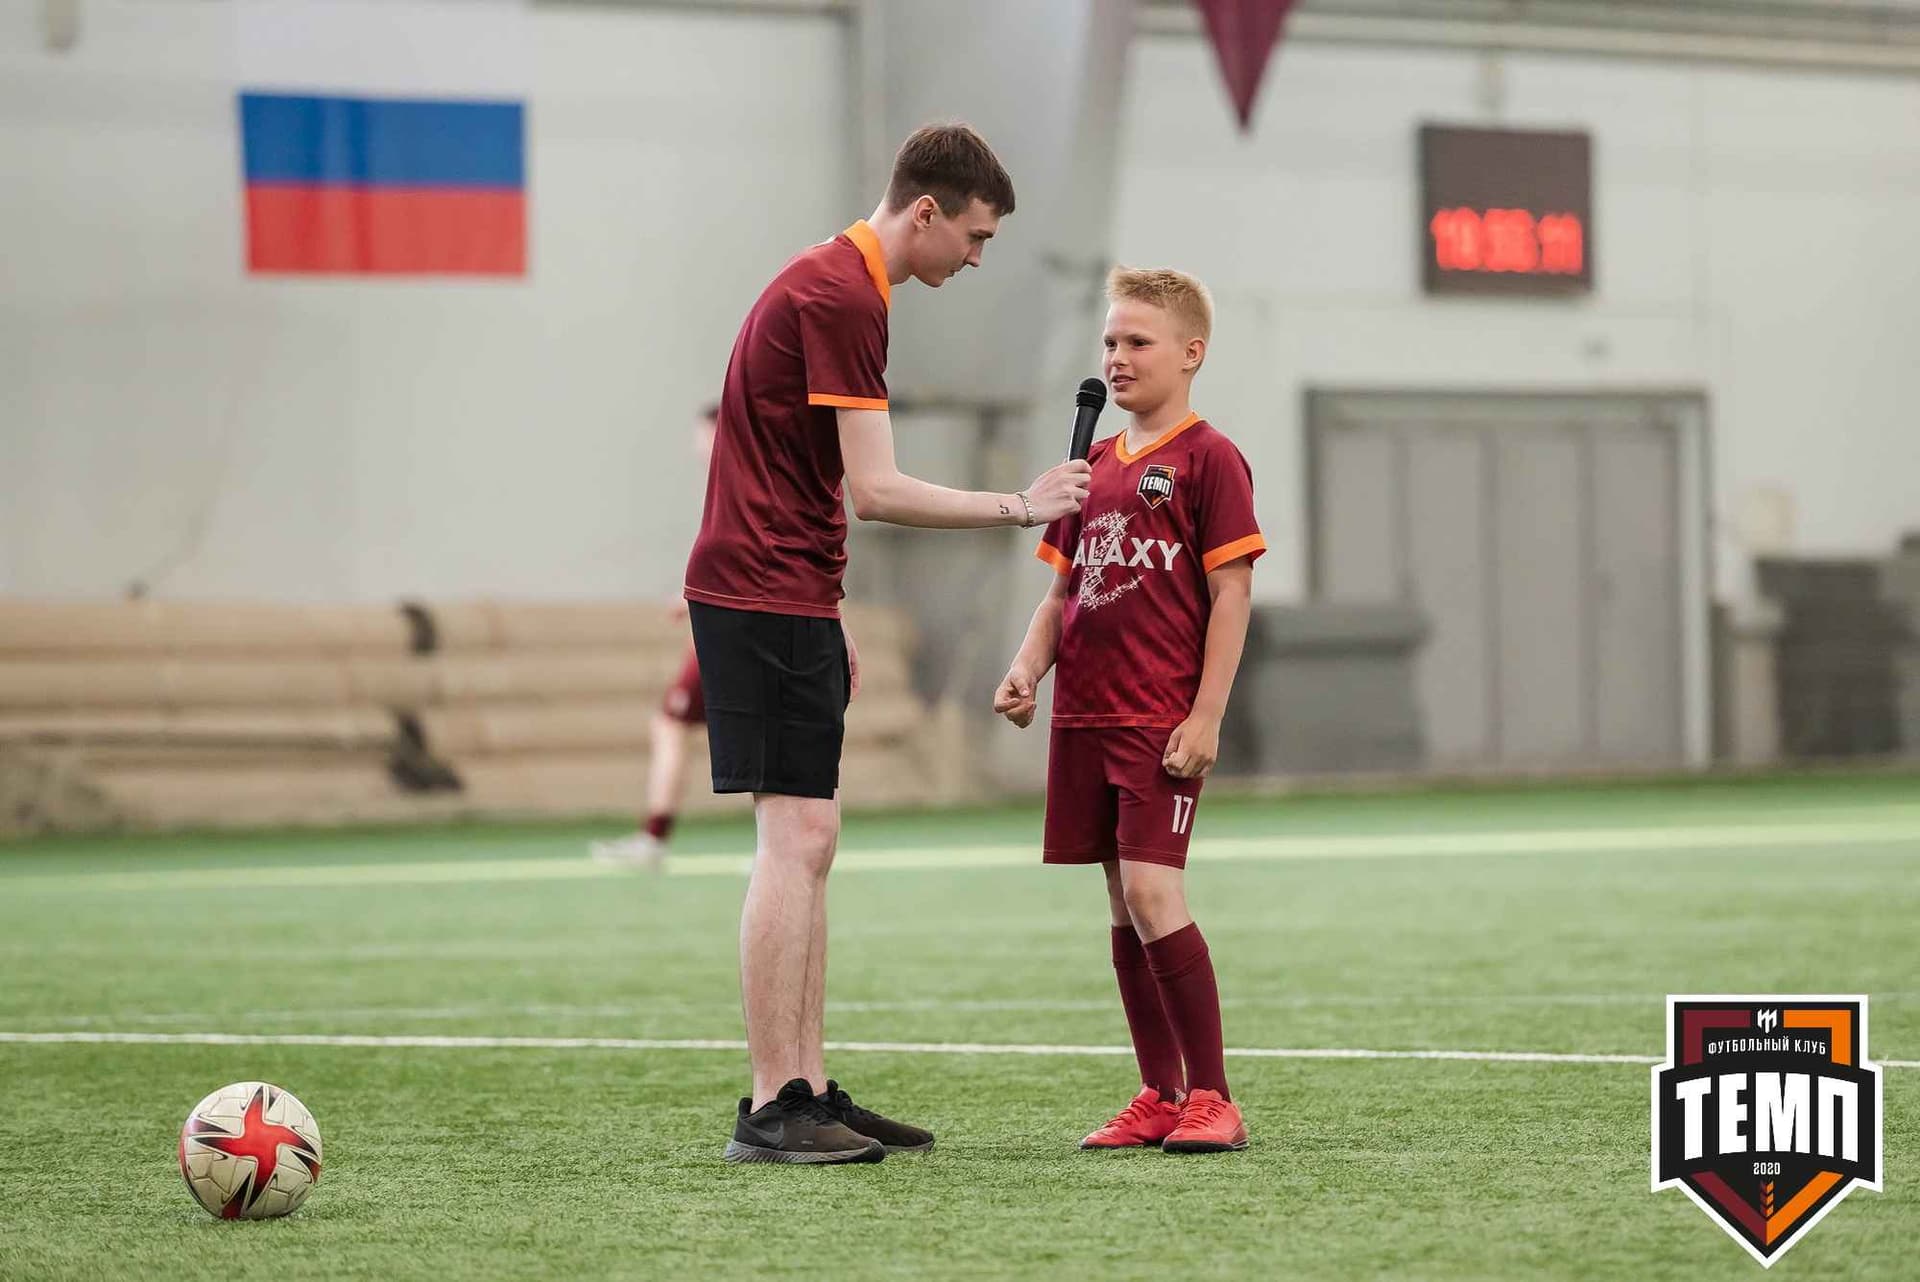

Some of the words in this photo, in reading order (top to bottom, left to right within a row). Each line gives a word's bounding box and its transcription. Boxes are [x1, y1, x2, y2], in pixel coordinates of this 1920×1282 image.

[1142, 475, 1171, 495] ТЕМП
[1072, 537, 1184, 571] ALAXY
[1171, 794, 1194, 835] 17
